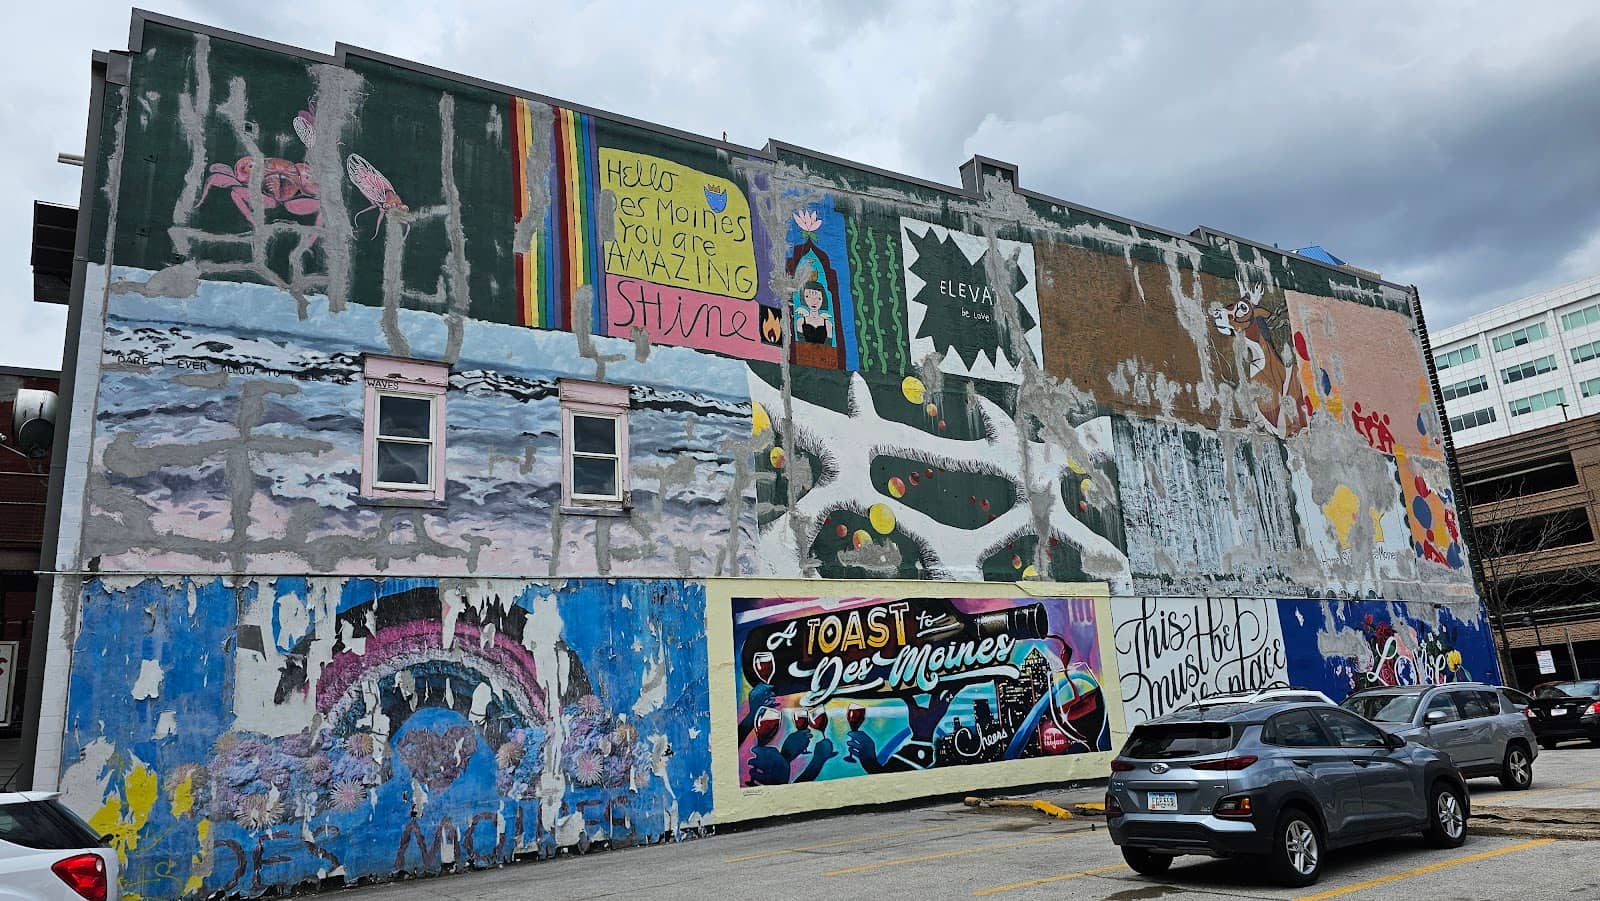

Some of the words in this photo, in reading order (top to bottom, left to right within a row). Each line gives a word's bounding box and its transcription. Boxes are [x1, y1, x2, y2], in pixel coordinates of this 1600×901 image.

[610, 196, 651, 218] es
[656, 199, 747, 242] Moines
[606, 239, 753, 294] AMAZING
[672, 232, 717, 257] are
[939, 279, 994, 306] ELEVA
[117, 354, 150, 366] DARE
[177, 359, 208, 371] EVER
[366, 380, 399, 390] WAVES
[766, 620, 797, 651] A
[807, 602, 909, 655] TOAST
[915, 611, 946, 629] to
[1114, 597, 1191, 682] This
[788, 655, 875, 707] Des
[872, 633, 1016, 692] Moines
